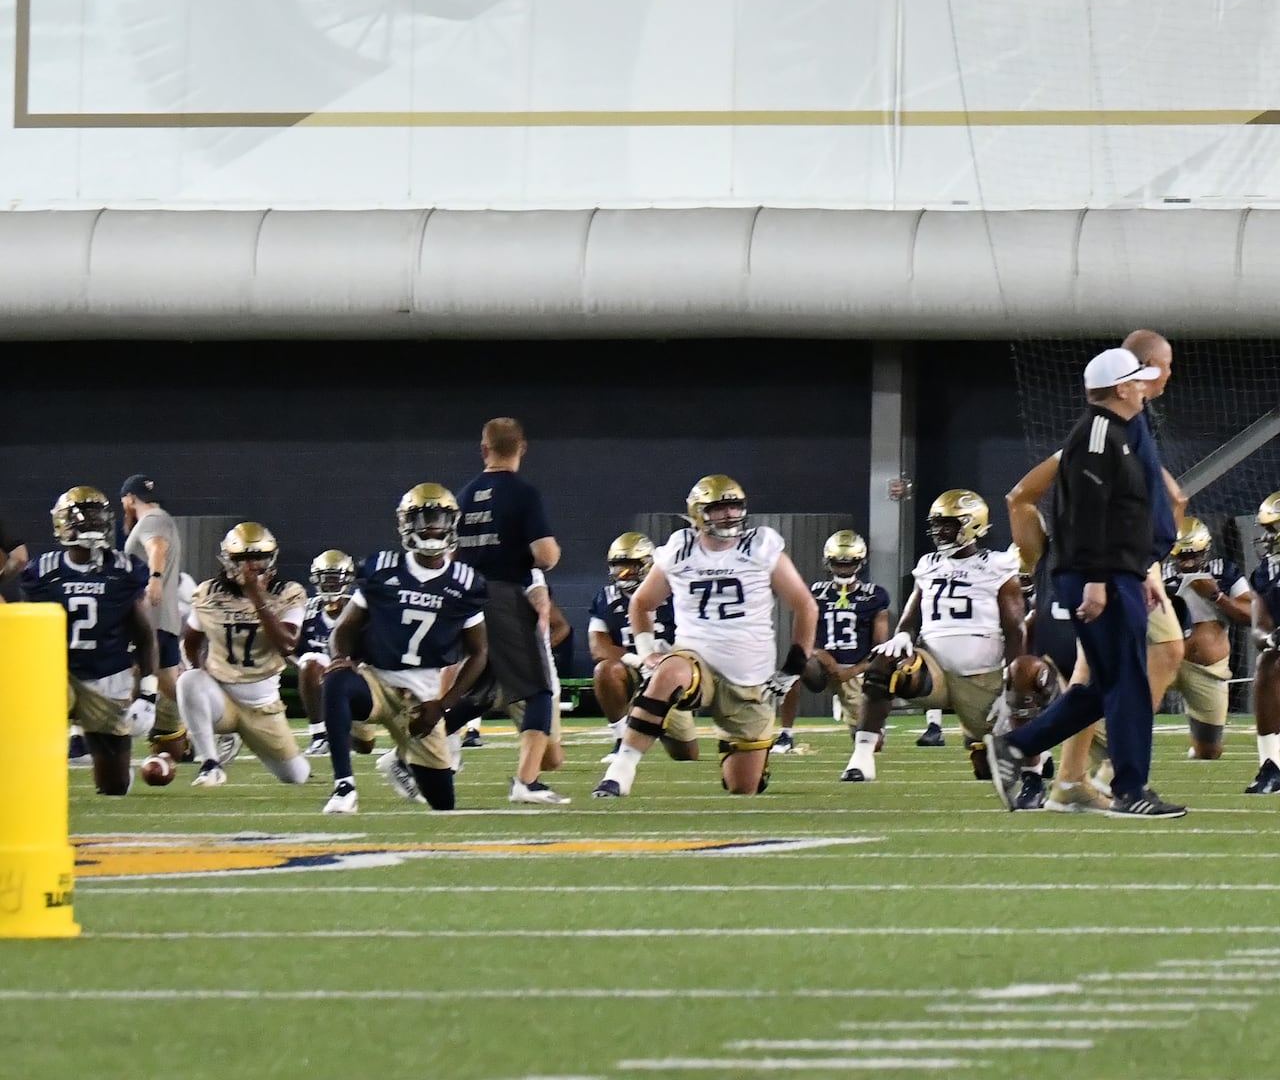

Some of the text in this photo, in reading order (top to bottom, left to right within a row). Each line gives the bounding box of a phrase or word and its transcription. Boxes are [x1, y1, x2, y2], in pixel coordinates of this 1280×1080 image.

[62, 582, 105, 595] TECH
[399, 589, 445, 609] TECH
[690, 578, 745, 620] 72
[826, 602, 856, 611] TH
[929, 578, 972, 620] 75
[67, 596, 97, 650] 2
[400, 609, 437, 666] 7
[824, 611, 858, 650] 13
[223, 623, 260, 667] 17
